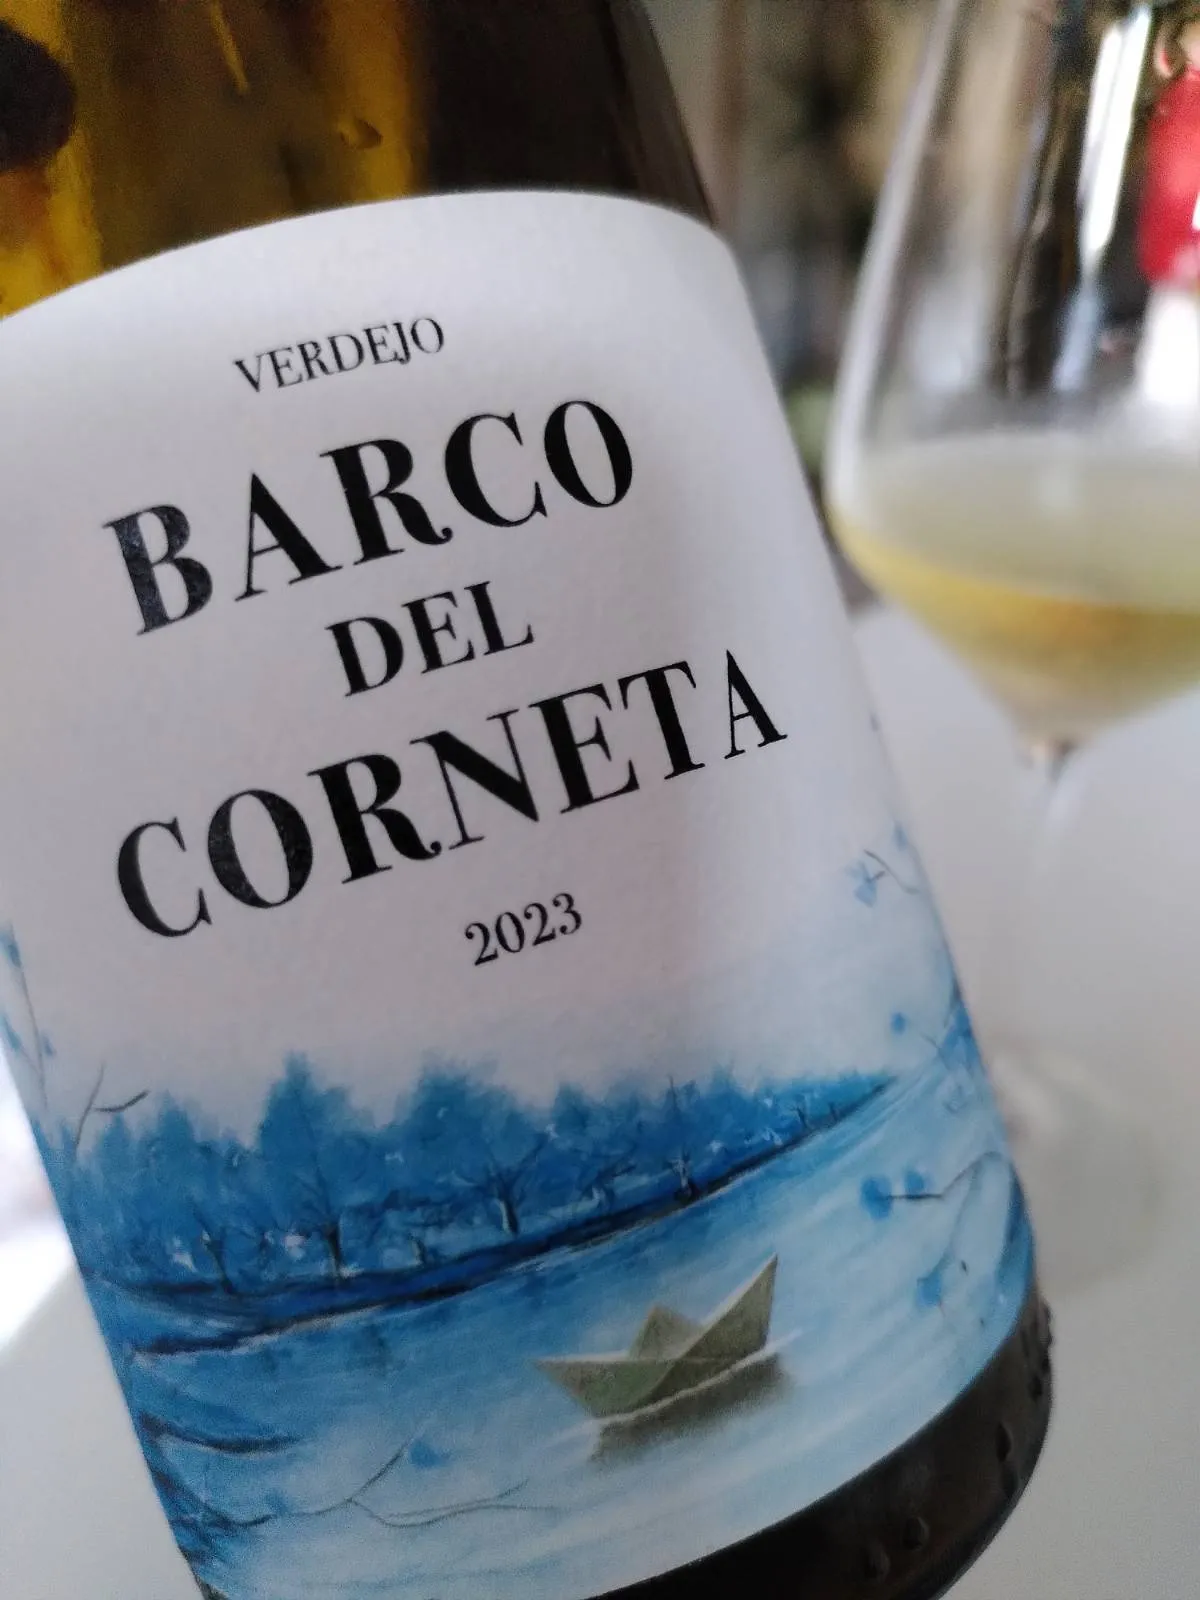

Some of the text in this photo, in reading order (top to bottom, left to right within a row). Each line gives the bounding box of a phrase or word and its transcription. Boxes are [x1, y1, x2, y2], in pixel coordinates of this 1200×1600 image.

[233, 316, 446, 393] VERDEJO
[102, 399, 635, 636] BARCO
[325, 581, 535, 698] DEL
[116, 648, 789, 939] CORNETA
[464, 891, 583, 967] 2023
